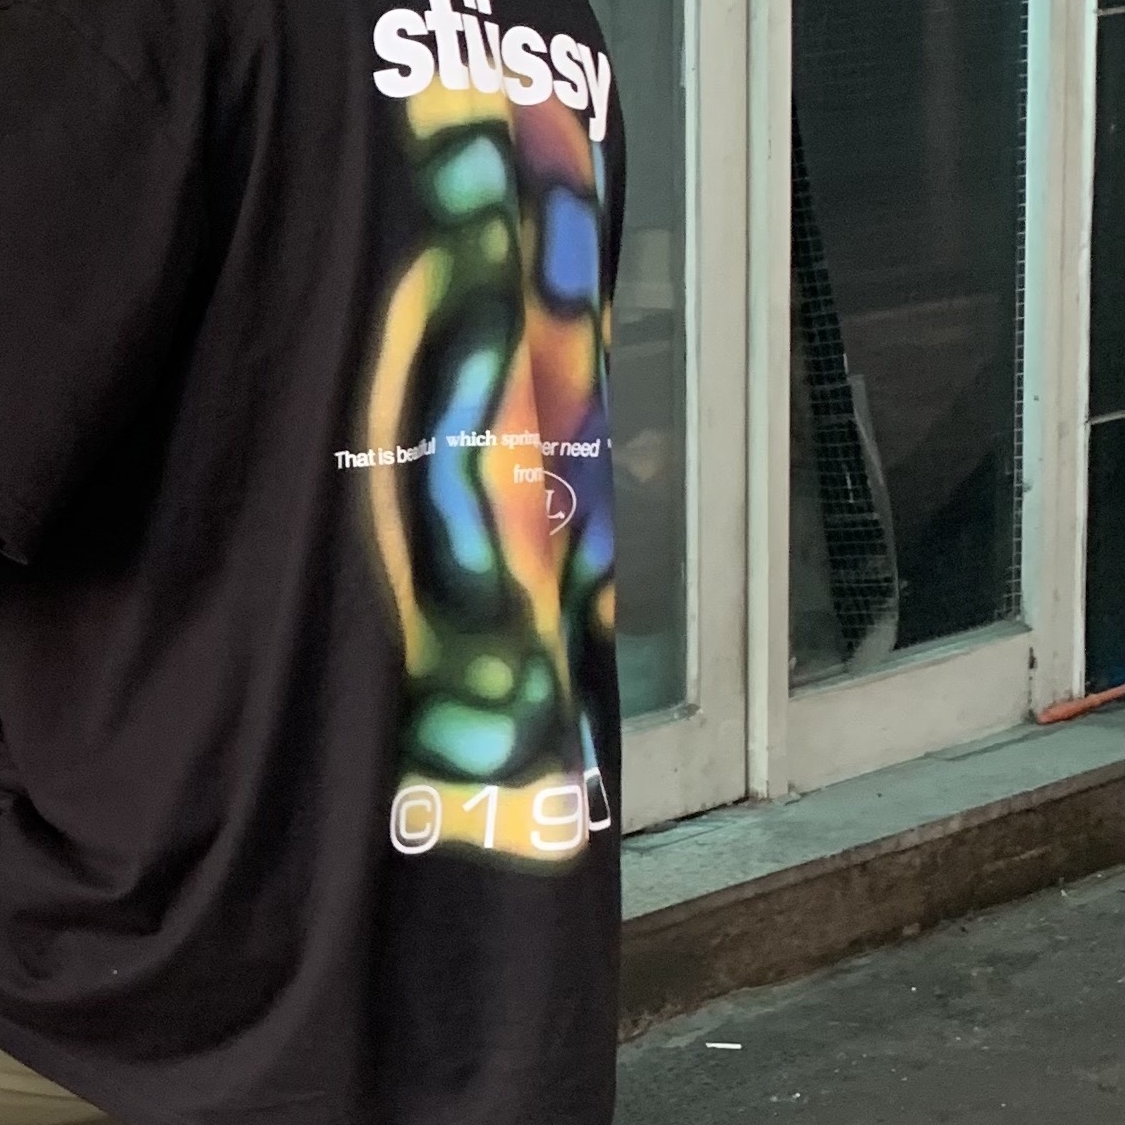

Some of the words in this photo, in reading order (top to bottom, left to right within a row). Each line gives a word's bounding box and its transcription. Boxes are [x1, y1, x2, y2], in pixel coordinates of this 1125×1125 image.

[446, 429, 497, 447] which
[559, 438, 601, 458] need
[334, 440, 376, 469] That
[377, 447, 395, 466] is
